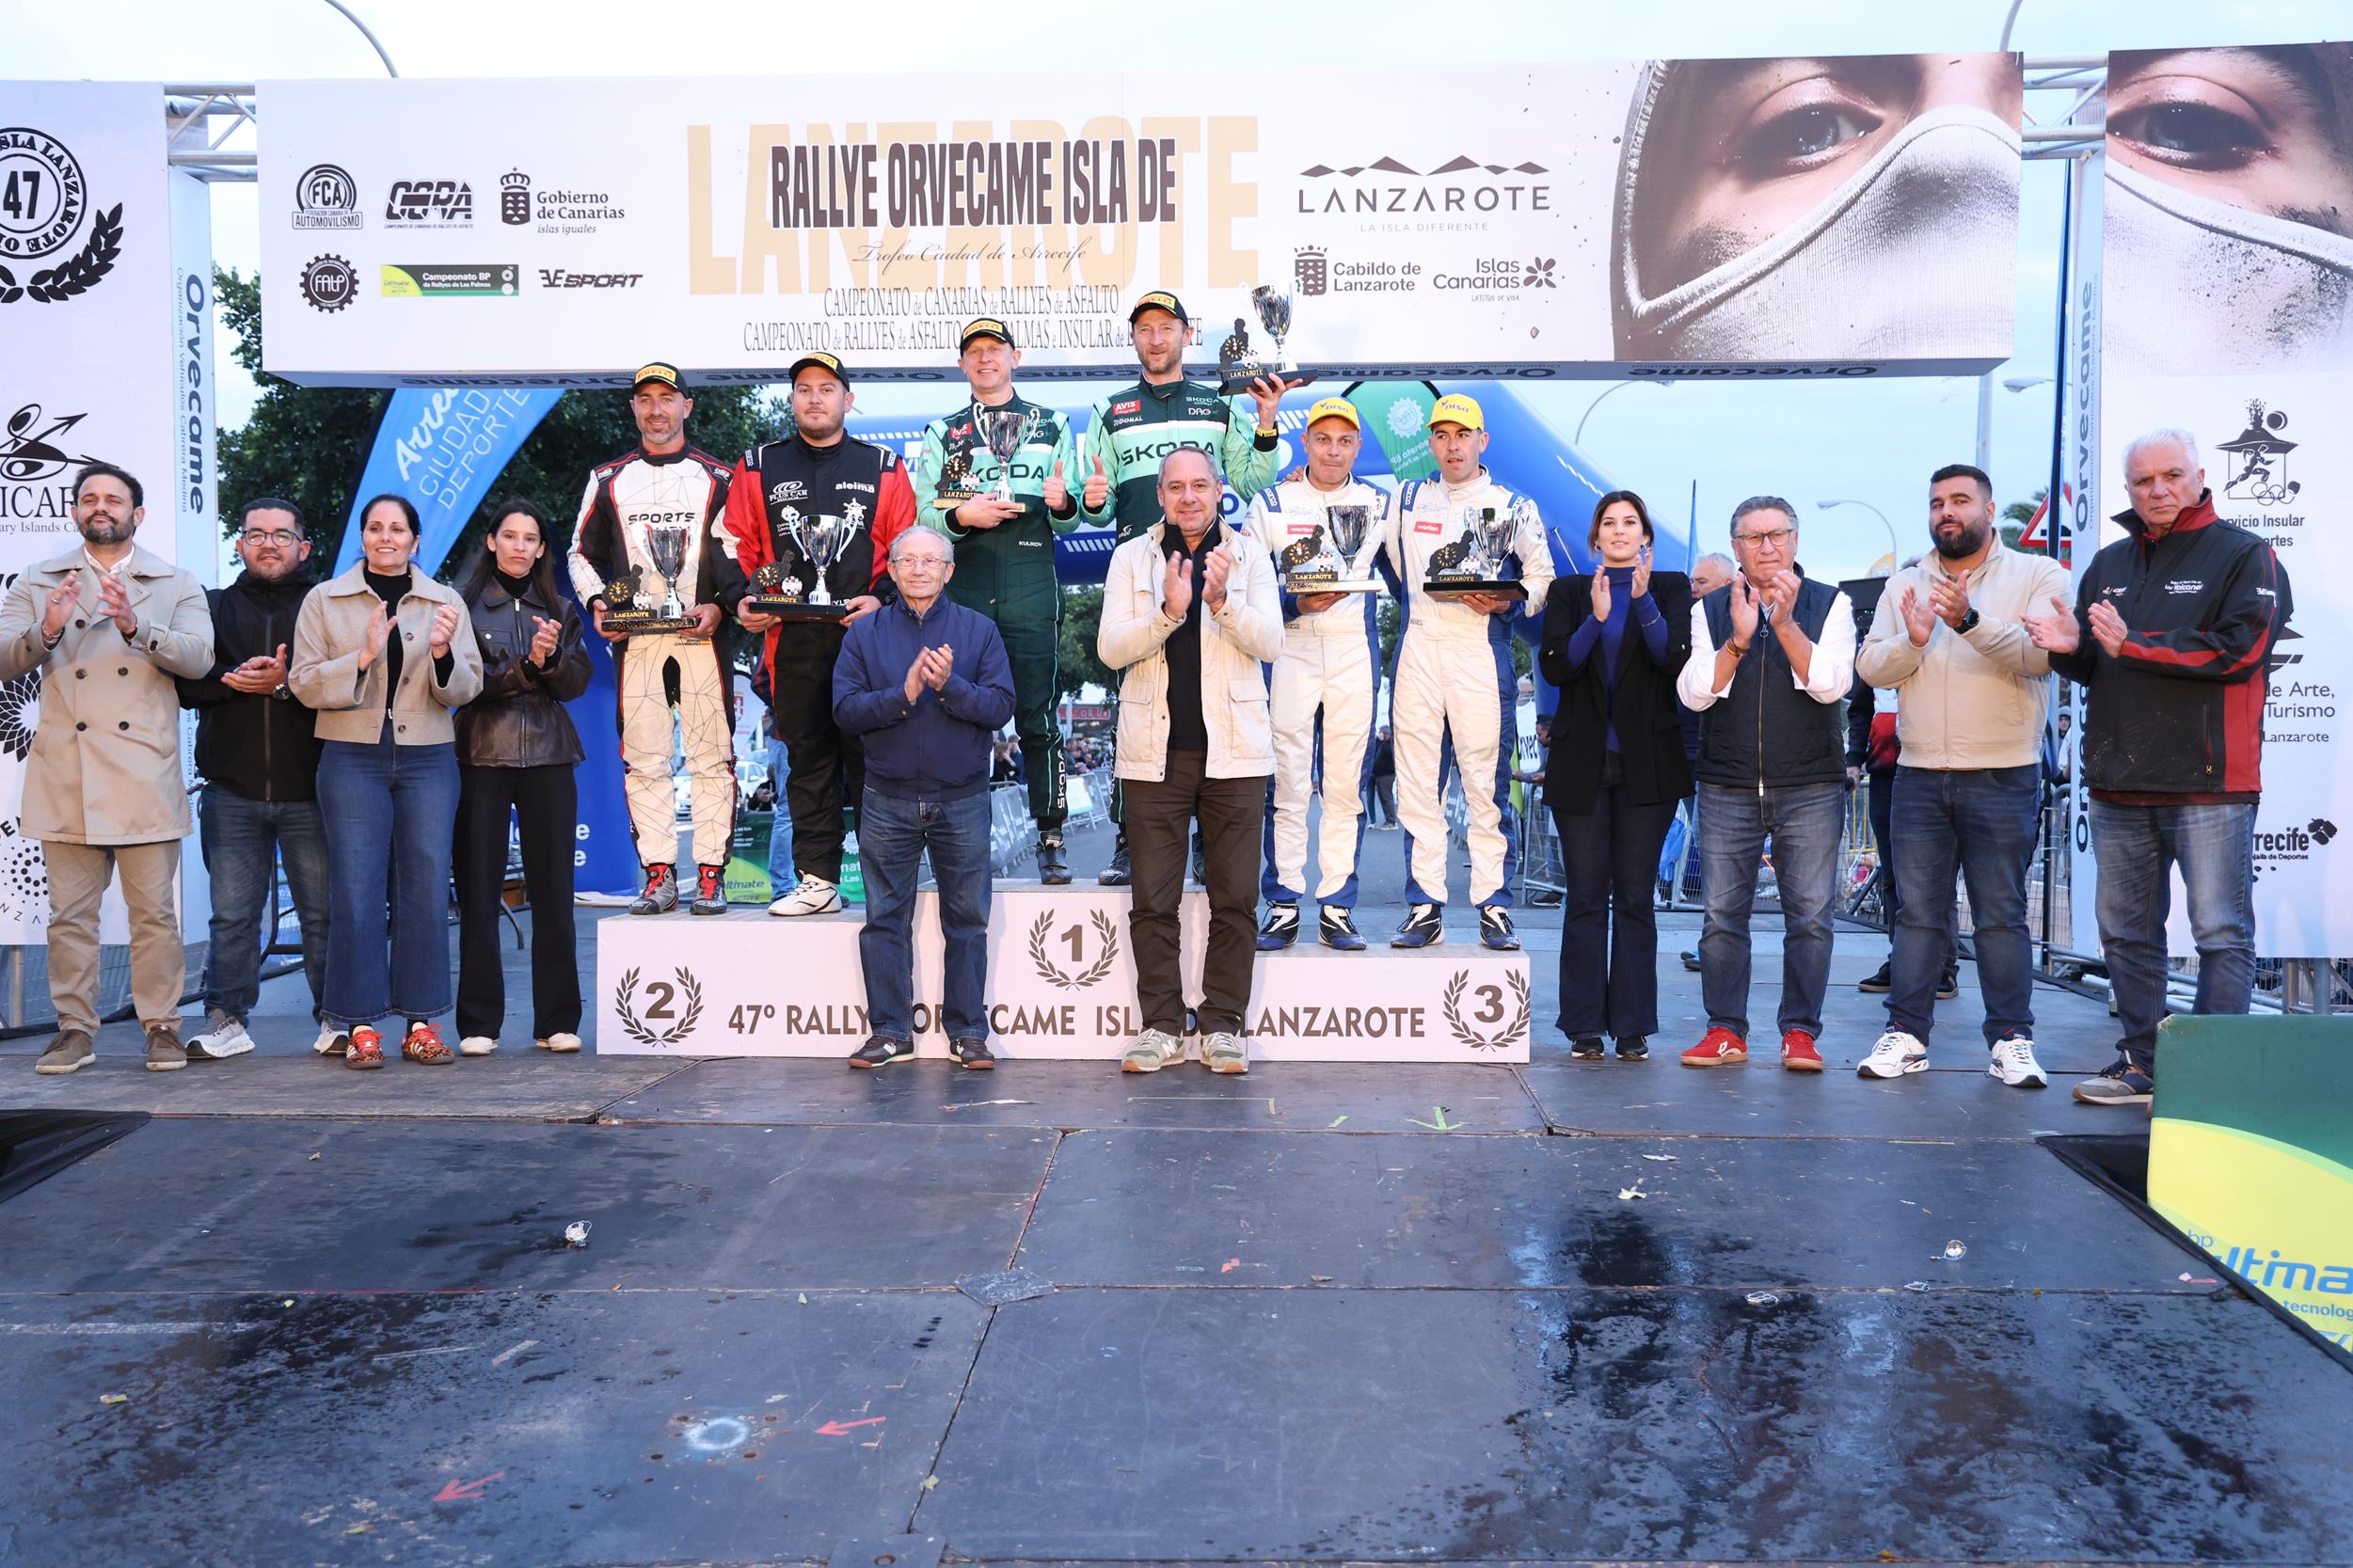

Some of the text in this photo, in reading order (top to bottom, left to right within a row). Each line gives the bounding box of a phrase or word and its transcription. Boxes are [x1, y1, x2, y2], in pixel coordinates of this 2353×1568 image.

[771, 138, 1176, 229] RALLYE ORVECAME ISLA DE
[3, 171, 40, 219] 47
[26, 142, 80, 252] LANZAROTE
[312, 181, 342, 206] FCA
[537, 191, 609, 205] Gobierno
[1298, 186, 1550, 214] LANZAROTE
[537, 205, 625, 219] de Canarias
[687, 115, 1259, 295] LANZAROTE
[295, 214, 359, 227] AUTOMOVILISMO
[1360, 223, 1489, 232] LA ISLA DIFERENTE
[538, 224, 596, 236] islas iguales
[851, 236, 1093, 276] Trofeo Ciudad de Arrecife
[1333, 261, 1422, 276] Cabildo de
[1476, 257, 1520, 274] Islas
[422, 273, 477, 281] Campeonato
[1333, 278, 1416, 292] Lanzarote
[1433, 274, 1519, 290] Canarias
[823, 284, 1119, 317] CAMPEONATO de CANARIAS de RALLYES de ASFALTO
[743, 320, 962, 352] CAMPEONATO de RALLYES de ASFALTO
[1053, 330, 1058, 348] e
[1059, 318, 1113, 348] INSULAR
[1115, 327, 1124, 348] de
[1230, 368, 1264, 378] LANZAROTE
[1317, 367, 1556, 378] Orvecame
[1629, 367, 1878, 377] Orvecame
[402, 376, 633, 387] Orvecame
[185, 274, 205, 515] Orvecame
[1116, 401, 1137, 411] AVIS
[1188, 407, 1212, 416] DAG
[2075, 281, 2092, 532] Orvecame
[180, 415, 188, 464] Cabrera
[419, 389, 491, 497] CIUDAD
[437, 388, 531, 511] DEPORTE
[181, 467, 189, 513] Medina
[769, 492, 789, 501] PLUS
[790, 488, 808, 497] CAR
[21, 522, 60, 532] Islands
[628, 512, 695, 525] SPORTS
[2264, 514, 2305, 527] Insular
[2289, 681, 2335, 699] Arte,
[2266, 702, 2336, 718] Turismo
[2263, 730, 2329, 742] Lanzarote
[1060, 925, 1083, 962] 1
[644, 982, 675, 1019] 2
[1473, 985, 1505, 1023] 3
[1240, 1006, 1425, 1037] LANZAROTE
